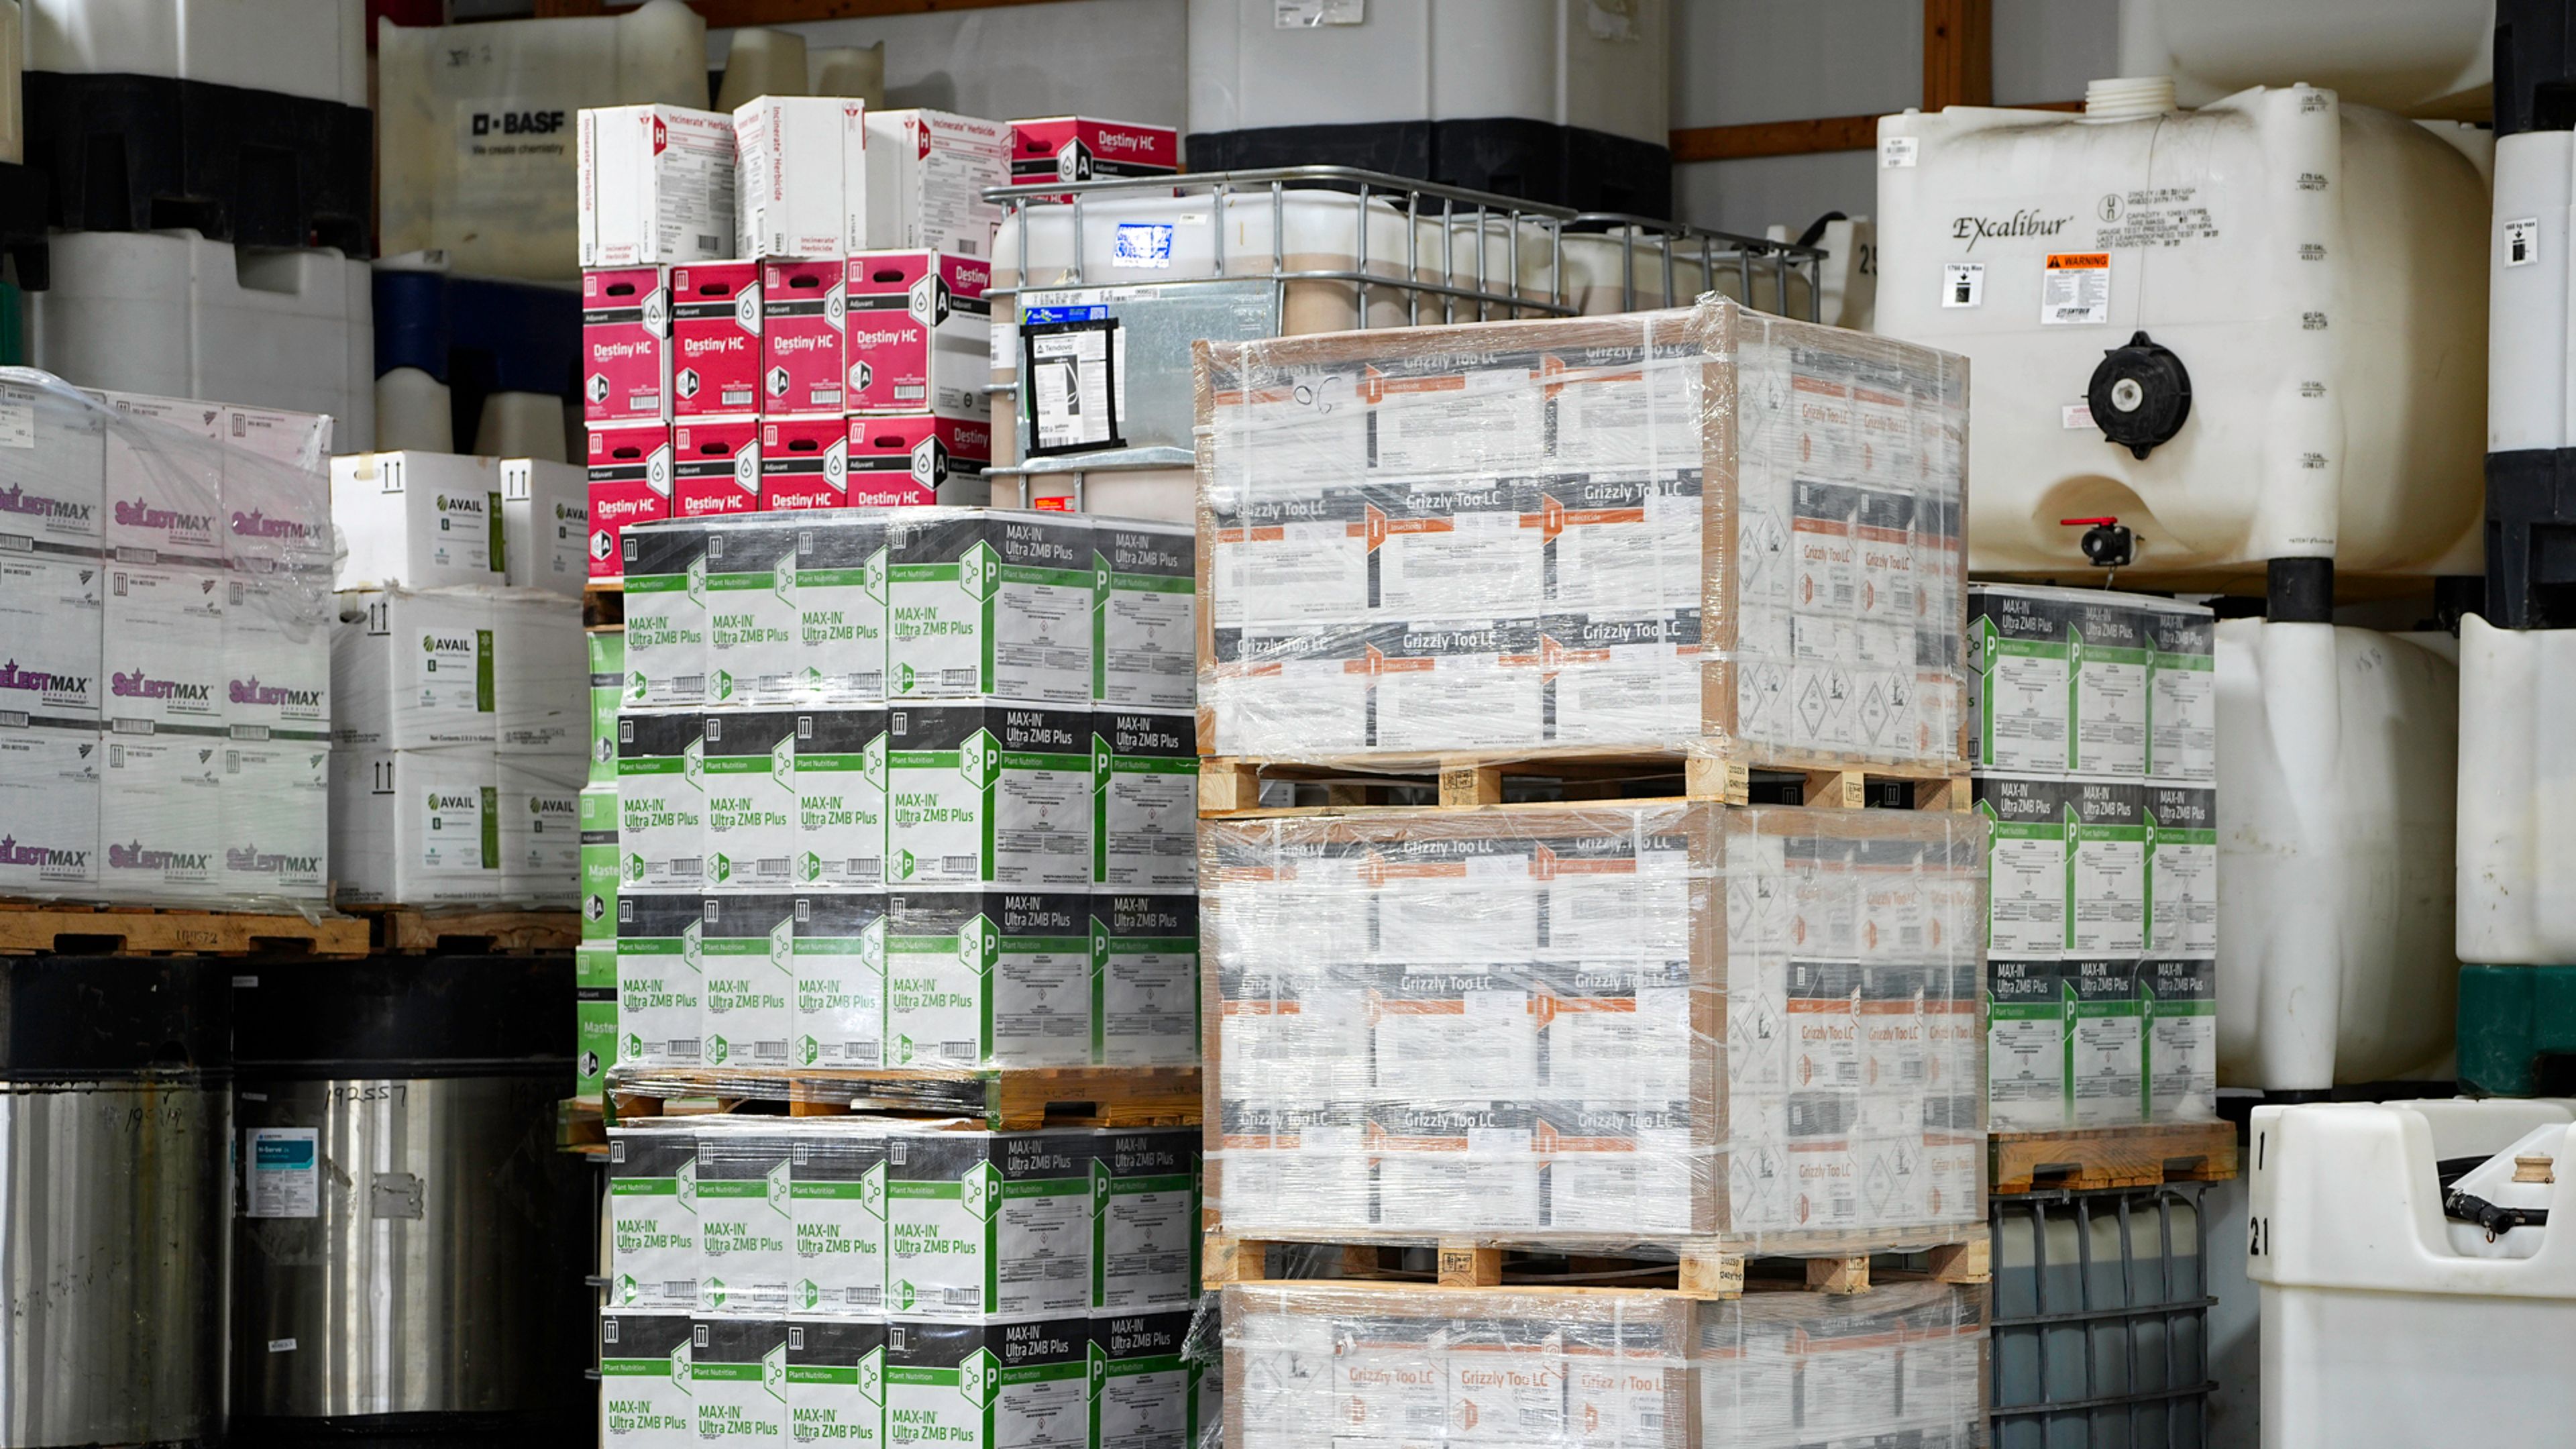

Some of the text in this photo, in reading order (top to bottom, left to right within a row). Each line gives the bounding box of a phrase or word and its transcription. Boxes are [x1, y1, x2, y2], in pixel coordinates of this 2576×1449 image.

[504, 111, 564, 133] BASF
[932, 118, 996, 138] Incinerate Herbicide
[1099, 131, 1155, 151] Destiny HC
[474, 143, 564, 155] We create chemistry
[2065, 256, 2106, 266] WARNING
[849, 299, 873, 309] Adjuvant
[676, 307, 700, 317] Adjuvant
[774, 335, 833, 352] Destiny HC
[857, 329, 917, 346] Destiny HC
[594, 341, 651, 358] Destiny HC
[684, 337, 744, 354] Destiny HC
[1585, 484, 1631, 500] Grizzly
[1665, 482, 1682, 496] LC
[449, 498, 482, 513] AVAIL
[598, 498, 654, 514] Destiny HC
[1406, 492, 1503, 510] Grizzly Too LC
[115, 500, 211, 531] SELECTMAX
[566, 506, 588, 520] AVAI
[1568, 513, 1601, 521] Insecticide
[1007, 525, 1043, 540] MAX-IN
[1007, 542, 1073, 560] Ultra ZMB Plus
[1804, 545, 1849, 563] Grizzly Too LC
[892, 569, 934, 578] Plant Nutrition
[895, 606, 938, 621] MAX-IN
[2003, 600, 2031, 614] MAX-IN
[629, 616, 668, 630] MAX-IN
[895, 621, 973, 636] Ultra ZMB Plus
[2002, 615, 2052, 632] Ultra ZMB Plus
[629, 629, 701, 646] Ultra ZMB Plus
[1584, 624, 1631, 641] Grizzly
[1664, 621, 1681, 636] LC
[436, 637, 470, 651] AVAIL
[1403, 630, 1500, 651] Grizzly Too LC
[0, 669, 86, 693] ELECTMAX
[112, 672, 209, 700] SELECTMAX
[229, 679, 319, 706] SELECTMAX
[1008, 712, 1043, 727] MAX-IN
[1008, 728, 1072, 743] Ultra ZMB Plus
[892, 755, 934, 764] Plant Nutrition
[440, 796, 474, 809] AVAIL
[541, 800, 574, 812] AVAIL
[711, 799, 751, 811] MAX-IN
[711, 812, 786, 827] Ultra ZMB Plus
[109, 845, 207, 869] SELECTMAX
[227, 848, 317, 872] SELECTMAX
[589, 865, 619, 876] Maste
[1998, 963, 2025, 977] MAX-IN
[624, 980, 663, 992] MAX-IN
[1997, 979, 2047, 994] Ultra ZMB Plus
[624, 994, 696, 1008] Ultra ZMB Plus
[1802, 1025, 1854, 1042] Grizzly Too LC
[325, 1085, 407, 1109] 192557
[1405, 1112, 1496, 1128] Grizzly Too LC
[1009, 1140, 1042, 1154] MAX-IN
[1009, 1155, 1071, 1171] Ultra ZMB Plus
[2251, 1217, 2268, 1256] 21
[1462, 1370, 1548, 1389] Grizzly Too LC
[794, 1409, 837, 1422] MAX-IN
[794, 1425, 872, 1439] Ultra ZMB Plus
